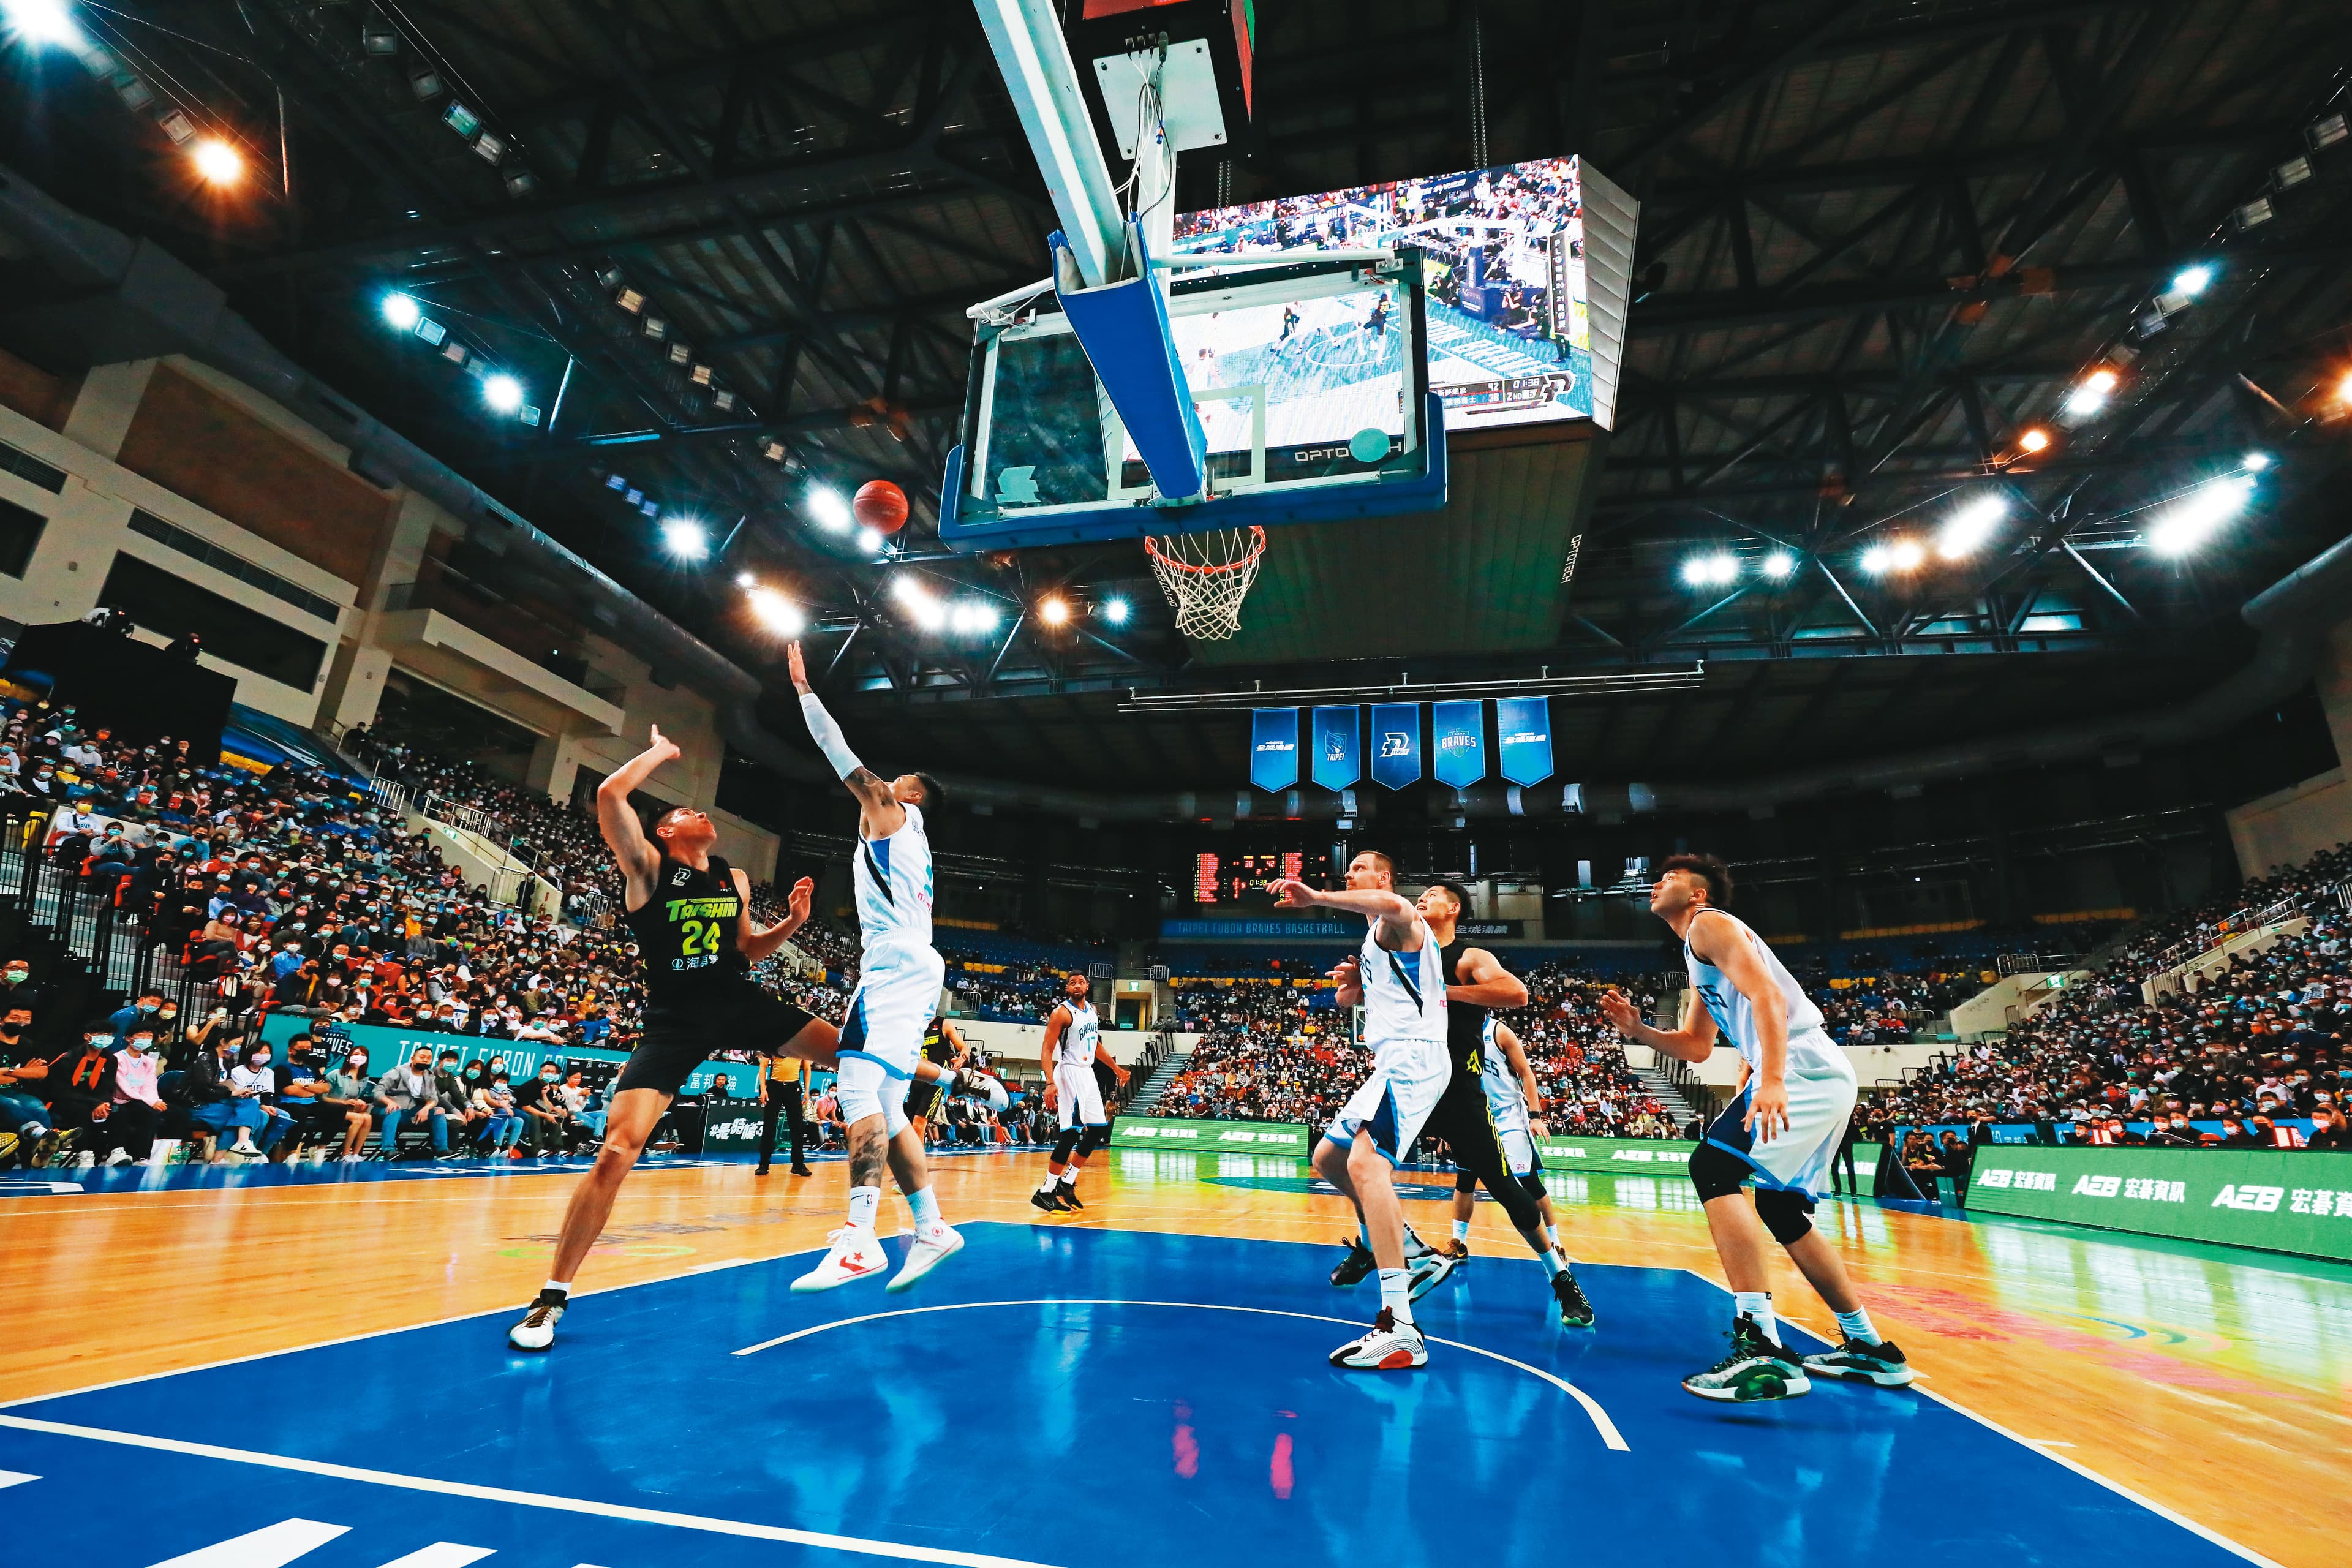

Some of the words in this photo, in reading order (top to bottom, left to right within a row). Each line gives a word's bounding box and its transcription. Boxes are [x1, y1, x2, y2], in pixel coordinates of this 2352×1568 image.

[1488, 382, 1499, 392] 42
[1513, 377, 1540, 389] 01:38
[1294, 442, 1402, 462] OPTOH
[1561, 533, 1583, 584] OPTOTECH
[1441, 735, 1477, 749] BRAVES
[1327, 753, 1344, 761] TAIPEI
[666, 898, 738, 922] TAISHIN
[1177, 922, 1208, 933] TAIPEI
[1213, 922, 1242, 933] FUBON
[1246, 922, 1281, 933] BRAVES
[1286, 922, 1346, 934] BASKETBALL
[682, 920, 721, 956] 24
[398, 1040, 469, 1072] TAPI
[690, 1072, 737, 1091] 富邦險
[1977, 1169, 2013, 1188] AEB
[2071, 1175, 2122, 1198] AEB
[2124, 1178, 2185, 1203] 宏碁資訊
[2211, 1184, 2285, 1212] AEB
